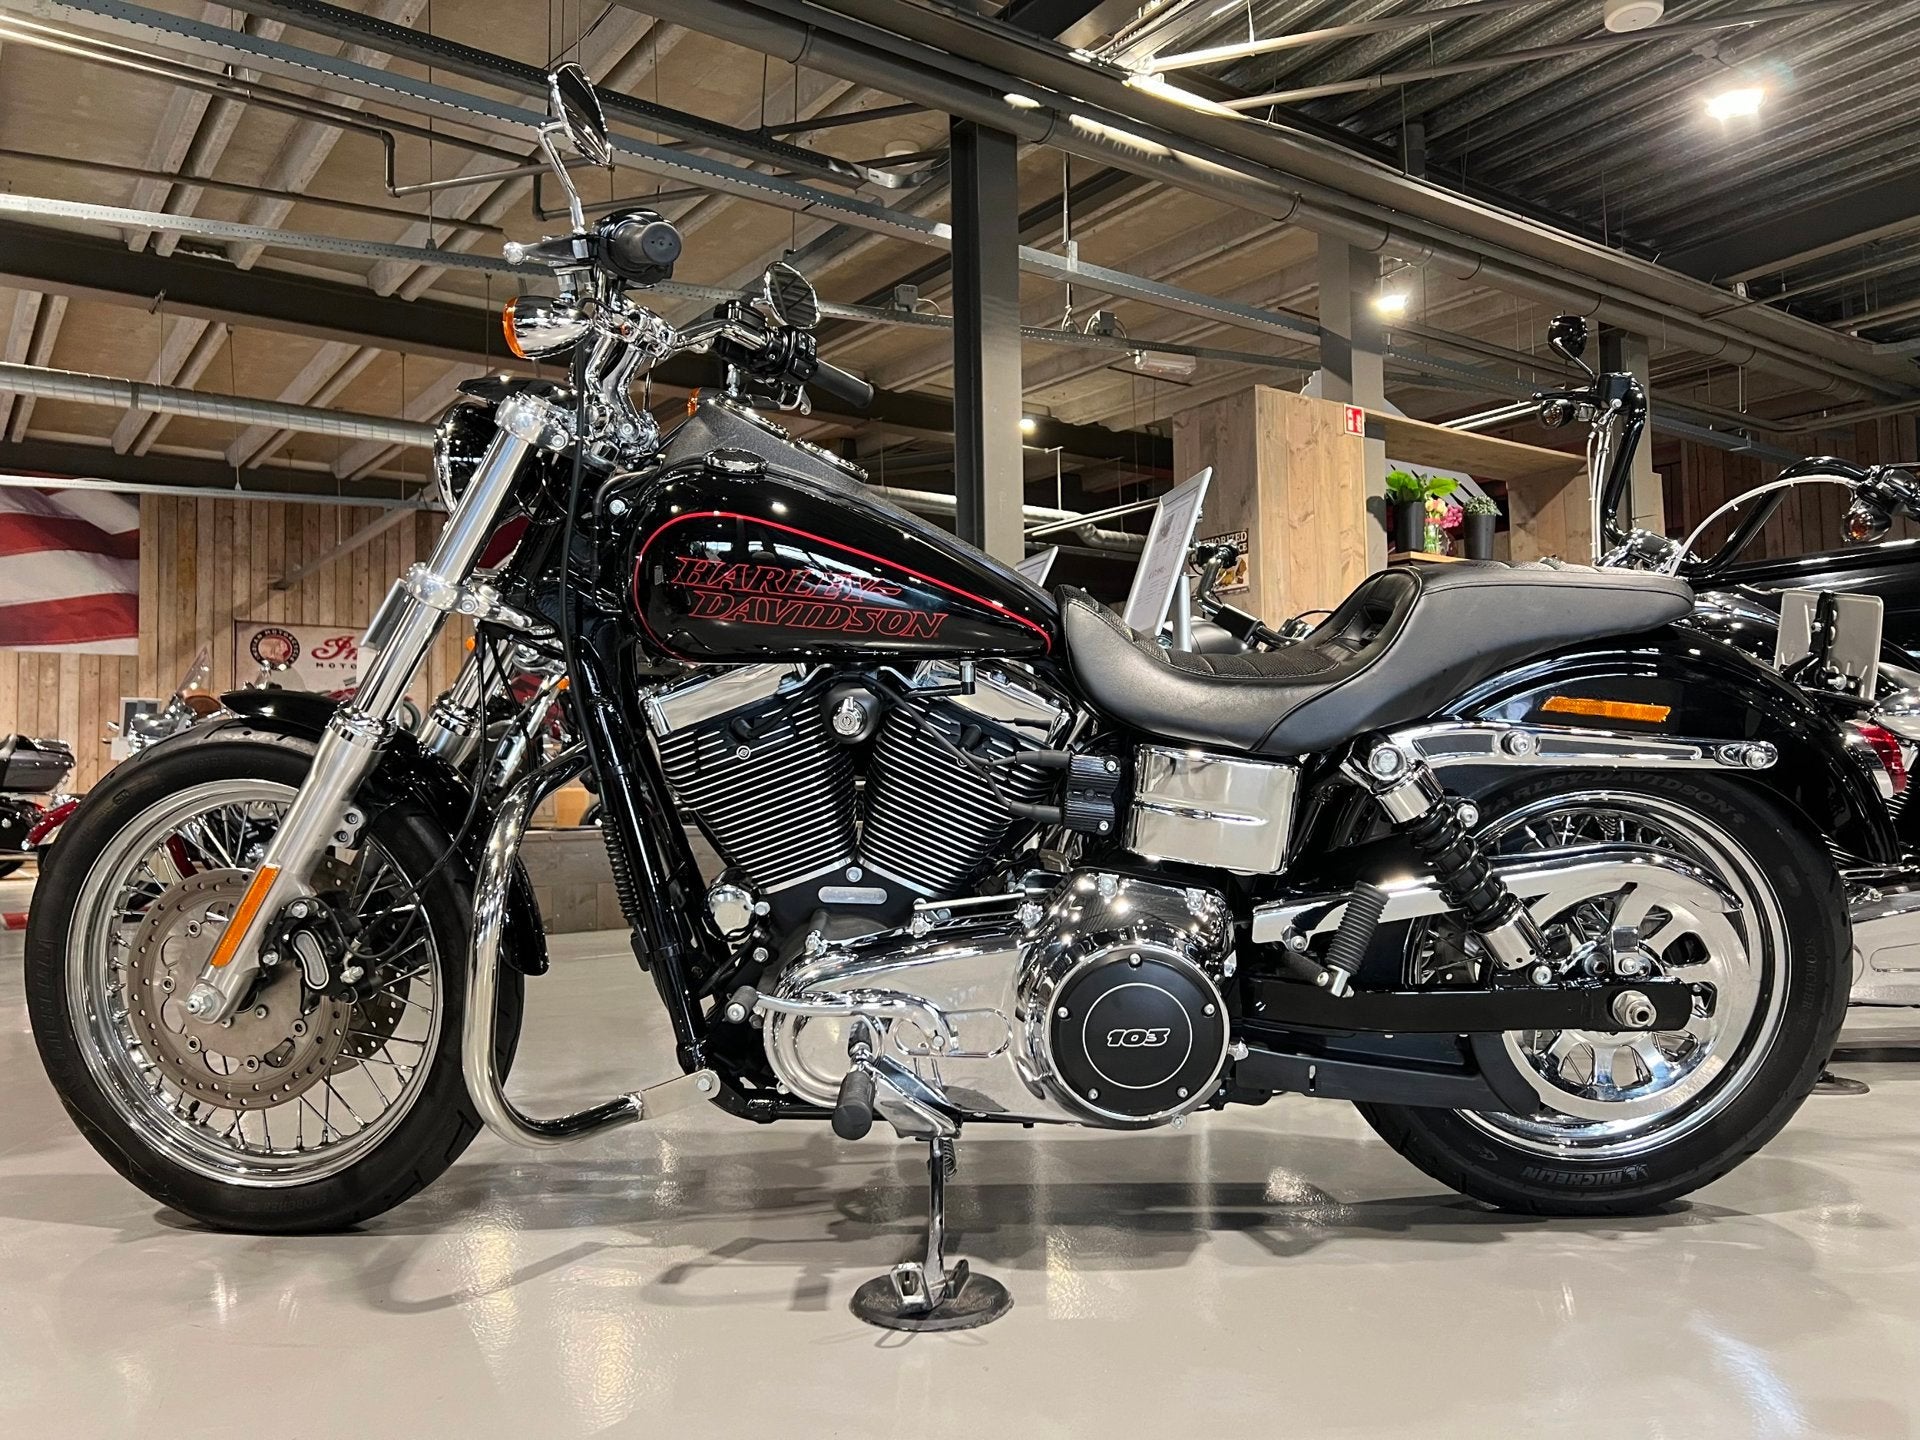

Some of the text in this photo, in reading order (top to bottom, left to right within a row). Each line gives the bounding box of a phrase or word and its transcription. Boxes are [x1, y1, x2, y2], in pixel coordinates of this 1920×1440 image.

[689, 591, 949, 638] DAVIDSON
[1107, 1028, 1170, 1047] 103
[1521, 1166, 1623, 1185] MICHELIN
